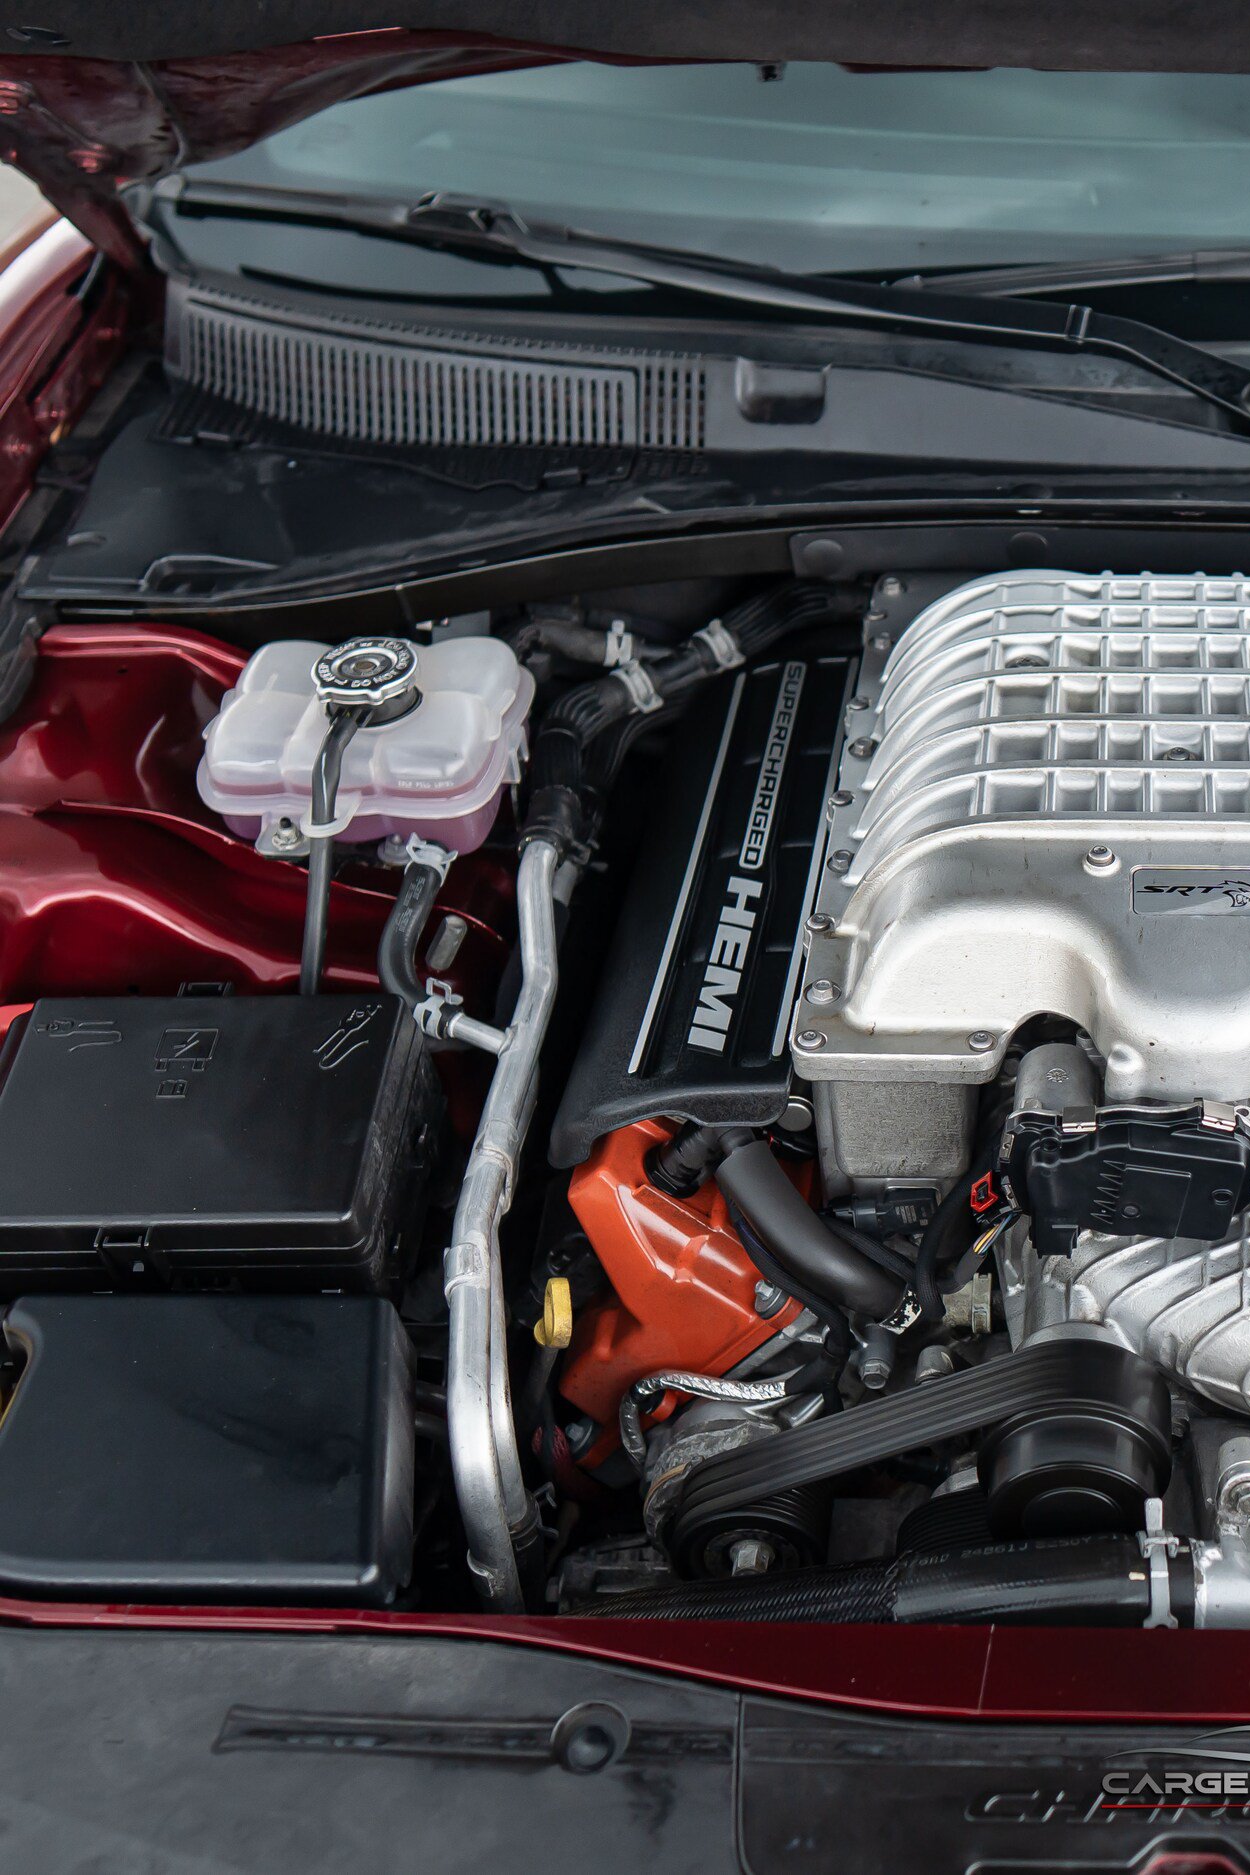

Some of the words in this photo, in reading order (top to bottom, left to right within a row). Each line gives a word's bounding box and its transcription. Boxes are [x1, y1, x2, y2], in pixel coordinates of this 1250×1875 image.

[743, 664, 803, 866] SUPERCHARGED
[687, 875, 764, 1052] HEMI
[1136, 885, 1226, 897] SRT
